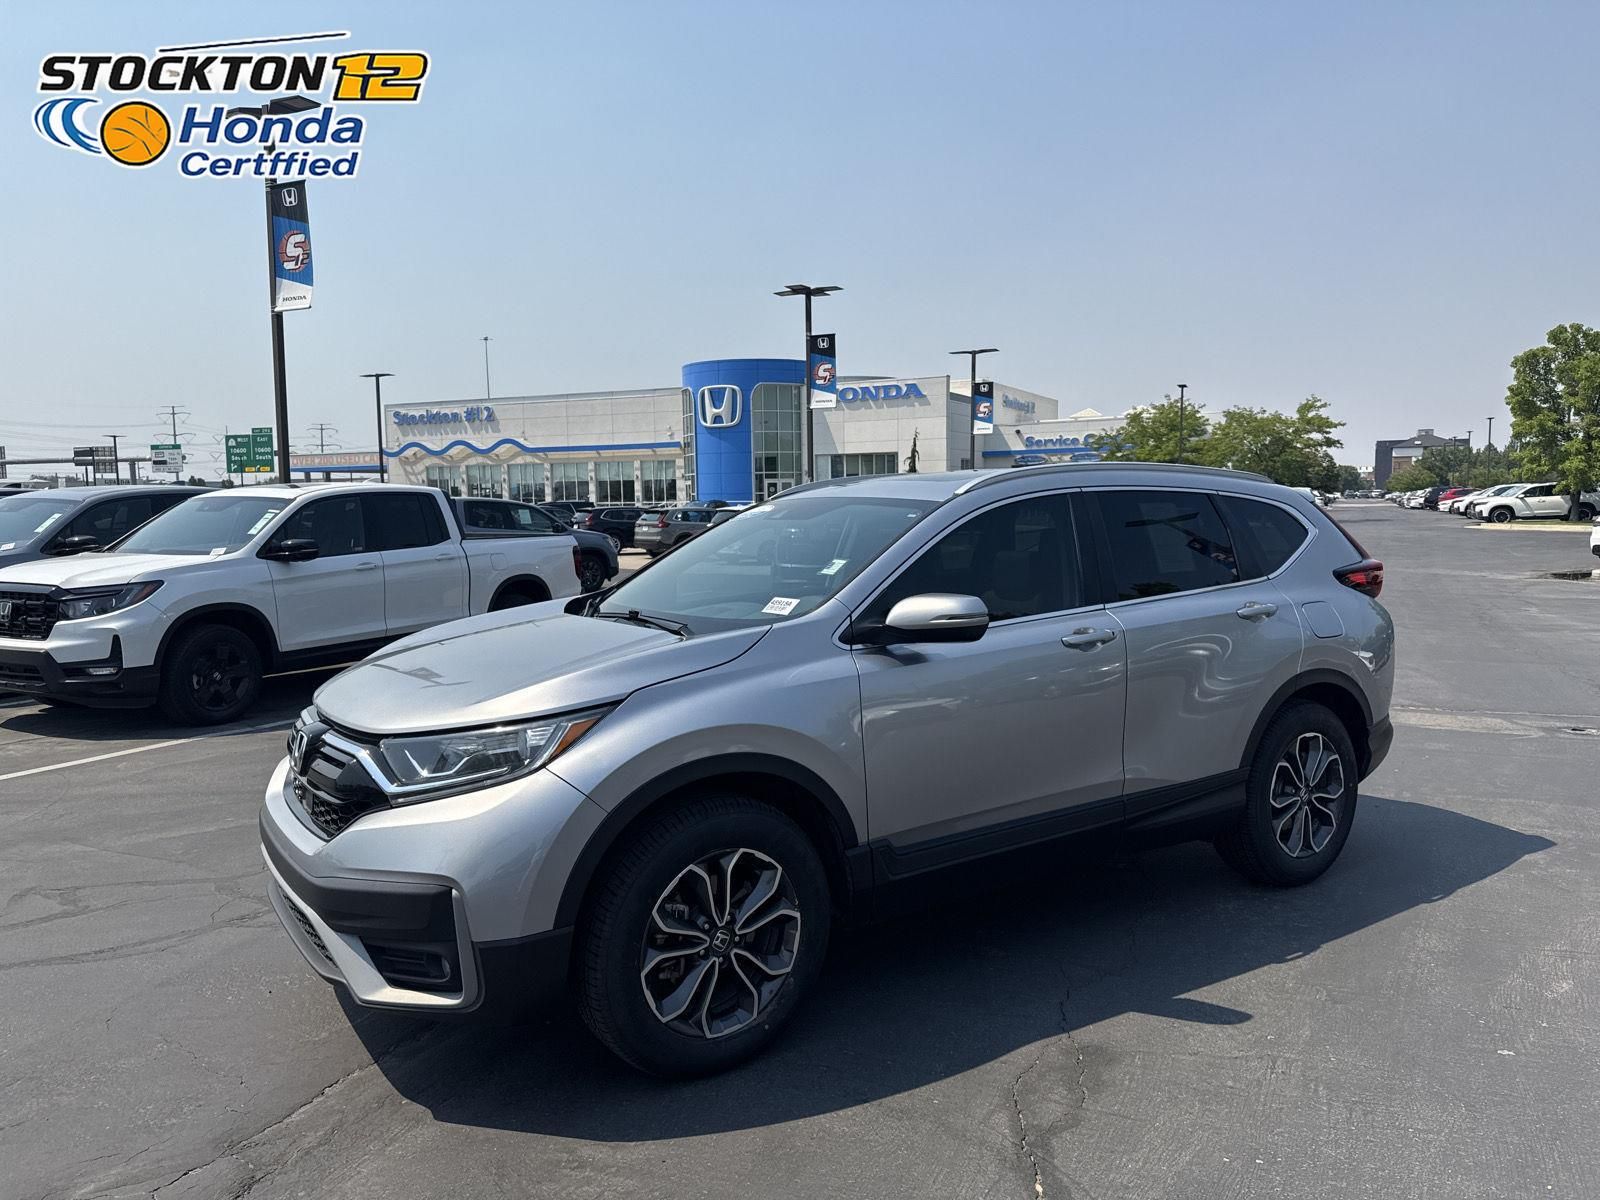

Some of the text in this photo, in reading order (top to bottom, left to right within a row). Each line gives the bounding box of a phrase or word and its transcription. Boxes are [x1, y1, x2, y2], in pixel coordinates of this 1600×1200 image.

[837, 383, 928, 403] ONDA
[393, 406, 494, 425] Stockton #12
[1025, 434, 1080, 448] Service
[292, 456, 316, 466] OVER
[336, 454, 360, 465] USED
